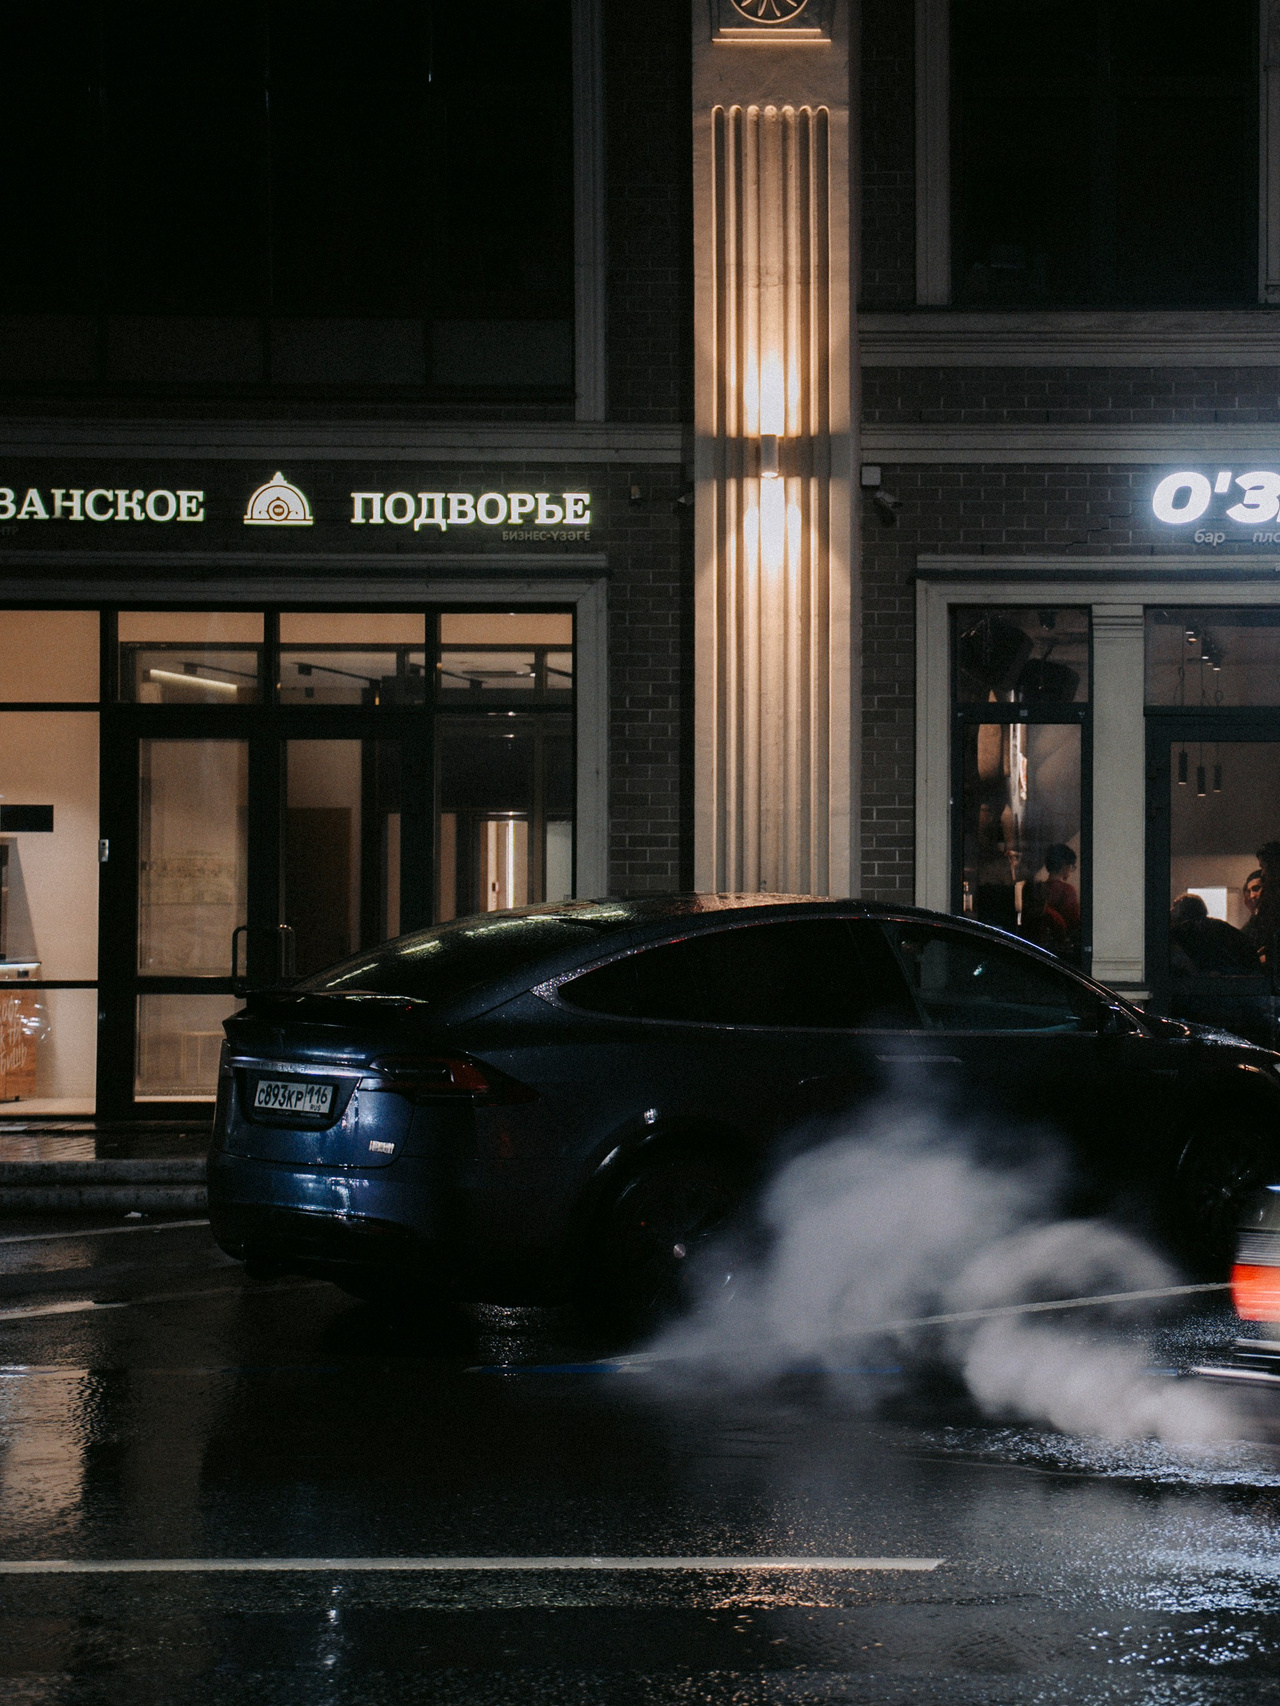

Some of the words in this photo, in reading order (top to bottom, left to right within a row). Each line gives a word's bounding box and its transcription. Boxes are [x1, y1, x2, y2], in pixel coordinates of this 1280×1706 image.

[351, 491, 592, 532] ПОДВОРЬЕ
[1194, 530, 1225, 546] бар
[257, 1084, 304, 1108] С893КР
[307, 1085, 328, 1104] 116
